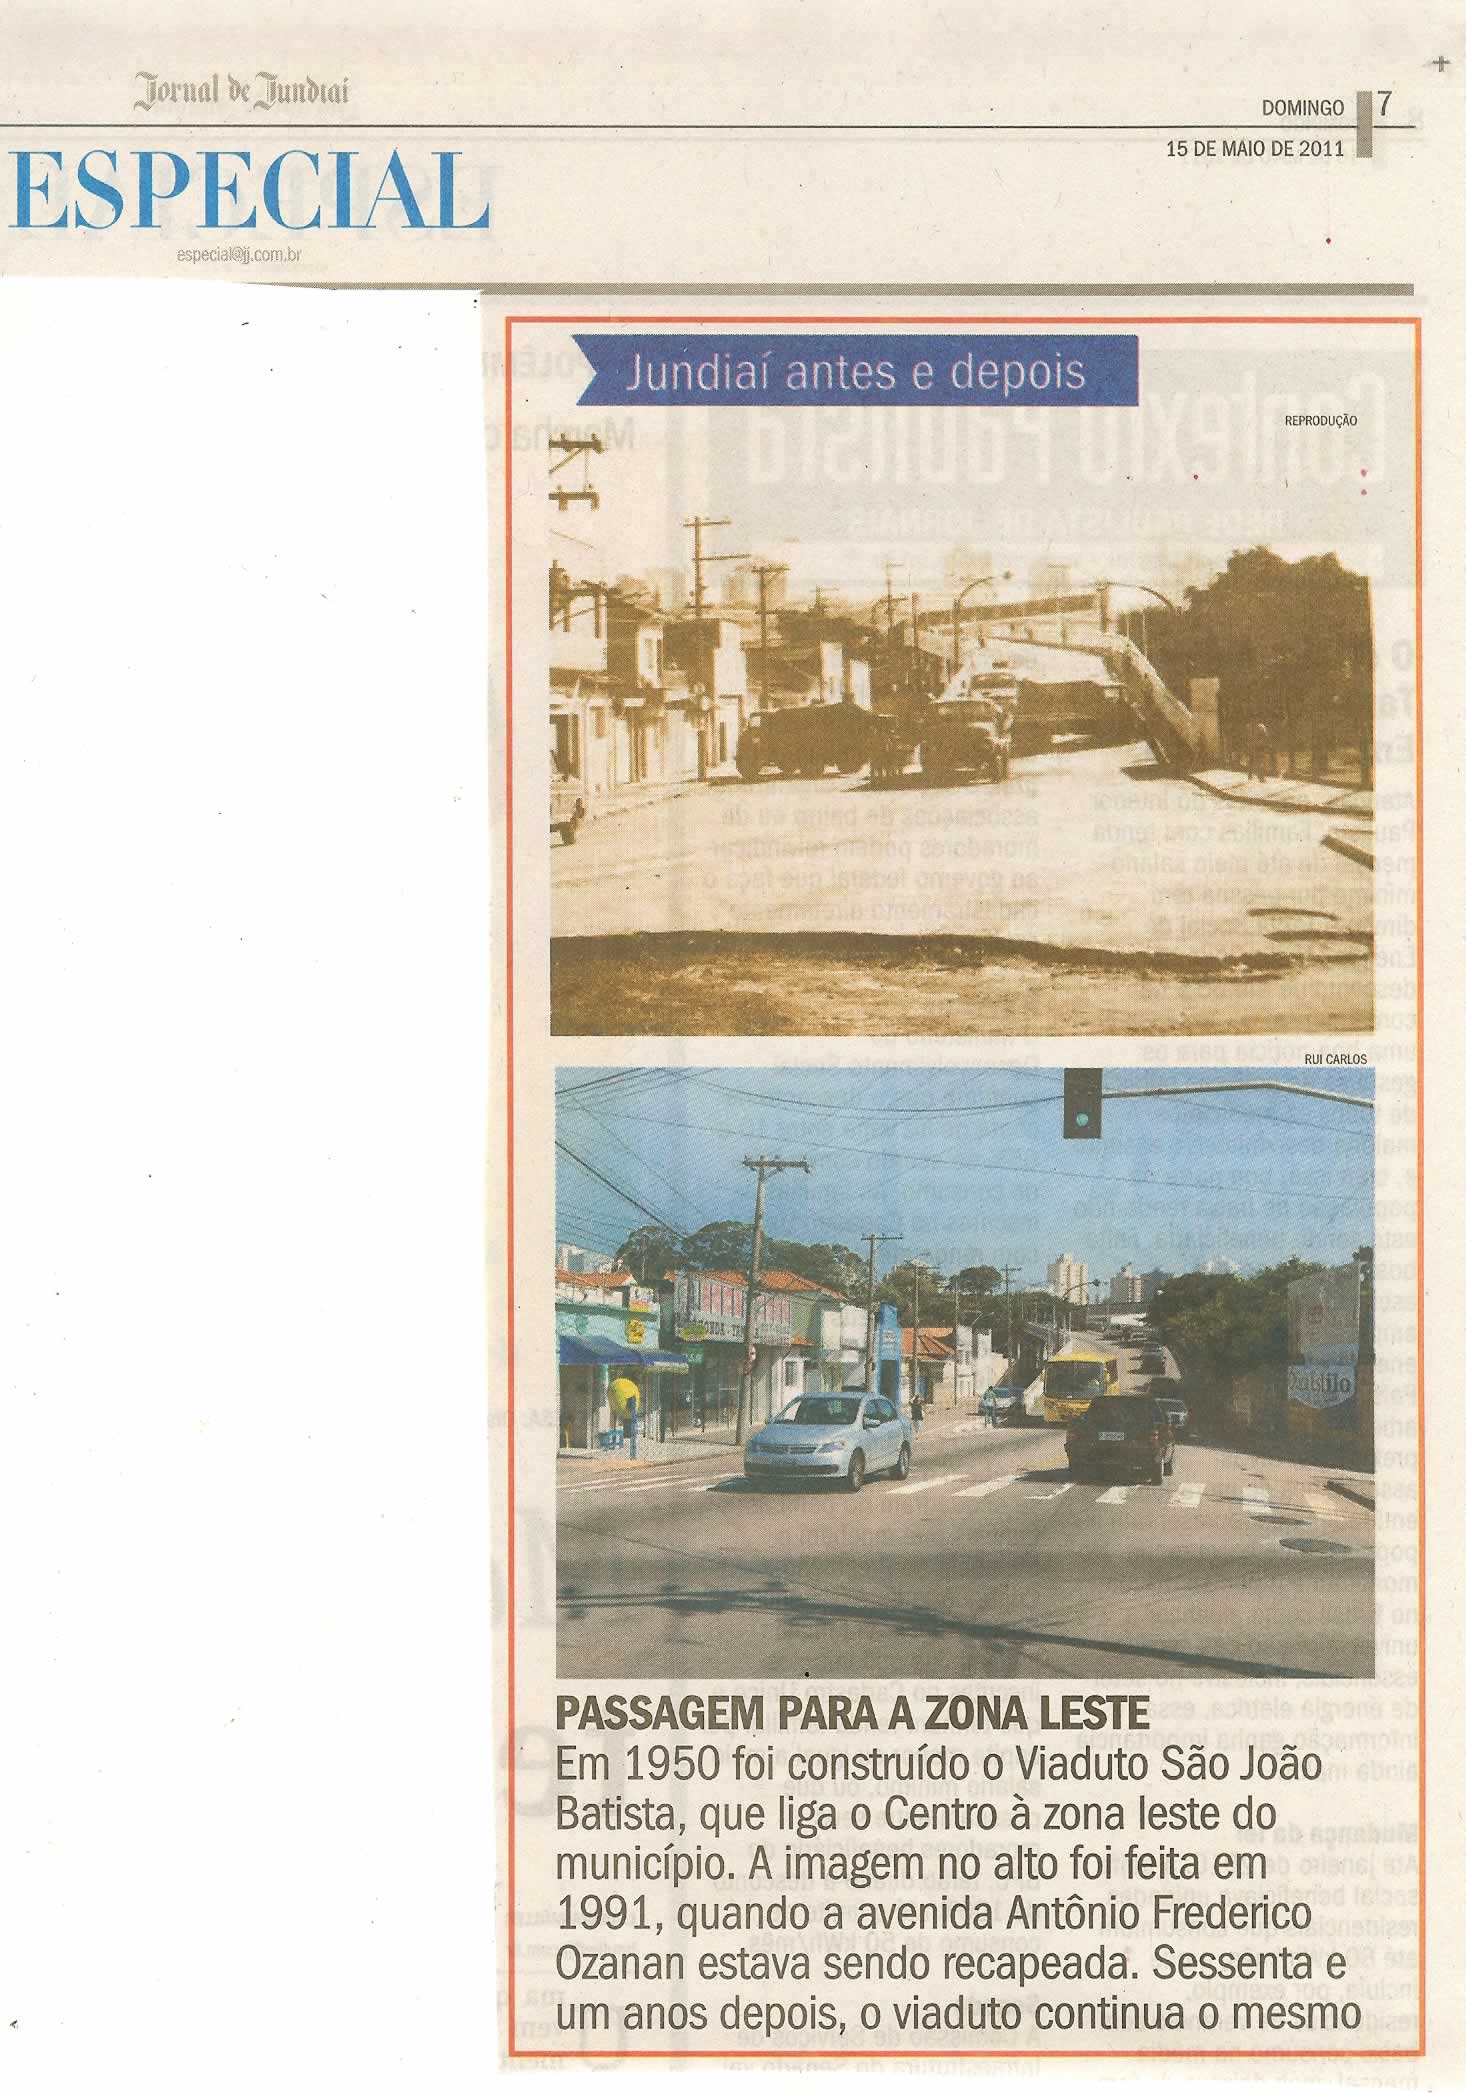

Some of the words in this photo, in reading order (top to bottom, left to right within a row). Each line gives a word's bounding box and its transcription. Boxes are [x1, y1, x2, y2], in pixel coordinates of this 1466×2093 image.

[134, 71, 219, 111] Jornal
[227, 72, 250, 103] de
[1263, 99, 1345, 116] DOMINGO
[1377, 90, 1393, 116] 7
[1167, 140, 1188, 157] 15
[1194, 140, 1217, 157] DE
[1222, 140, 1266, 157] MAIO
[1271, 140, 1294, 157] DE
[1299, 140, 1344, 157] 2011
[8, 147, 490, 230] ESPECIAL
[176, 246, 303, 265] especial@jj.com.br
[626, 350, 771, 391] Jundiaí
[785, 356, 896, 391] antes
[912, 361, 934, 391] e
[950, 351, 1086, 398] depois
[1285, 412, 1358, 430] REPRODUÇÃO
[1304, 1053, 1323, 1065] RUI
[1325, 1053, 1368, 1065] CARLOS
[556, 1694, 764, 1731] PASSAGEM
[779, 1695, 879, 1730] PARA
[887, 1695, 916, 1730] A
[924, 1694, 1029, 1730] ZONA
[1040, 1694, 1150, 1730] LESTE
[557, 1745, 609, 1780] Em
[627, 1744, 720, 1781] 1950
[732, 1744, 774, 1781] foi
[788, 1743, 970, 1781] construído
[983, 1753, 1004, 1781] o
[1015, 1744, 1149, 1781] Viaduto
[1161, 1744, 1230, 1781] São
[1239, 1744, 1322, 1781] João
[557, 1795, 686, 1836] Batista,
[700, 1803, 765, 1838] que
[779, 1795, 837, 1839] liga
[851, 1803, 871, 1831] o
[885, 1794, 998, 1831] Centro
[1010, 1793, 1031, 1831] à
[1043, 1803, 1125, 1831] zona
[1139, 1795, 1220, 1831] leste
[1232, 1795, 1277, 1830] do
[557, 1842, 735, 1888] município.
[748, 1845, 773, 1880] A
[785, 1844, 924, 1889] imagem
[939, 1852, 981, 1880] no
[994, 1844, 1058, 1880] alto
[1069, 1844, 1112, 1880] foi
[1124, 1844, 1200, 1880] feita
[1213, 1852, 1267, 1880] em
[559, 1894, 663, 1937] 1991,
[677, 1894, 810, 1938] quando
[823, 1903, 843, 1930] a
[855, 1894, 993, 1930] avenida
[1006, 1893, 1140, 1930] Antônio
[1154, 1894, 1312, 1930] Frederico
[556, 1944, 684, 1980] Ozanan
[698, 1947, 810, 1980] estava
[823, 1944, 930, 1980] sendo
[944, 1944, 1138, 1988] recapeada.
[1152, 1943, 1312, 1980] Sessenta
[1326, 1952, 1347, 1980] e
[557, 2003, 609, 2030] um
[623, 2002, 708, 2030] anos
[720, 1994, 846, 2038] depois,
[860, 2003, 881, 2030] o
[893, 1994, 1022, 2030] viaduto
[1034, 1994, 1185, 2030] continua
[1198, 2002, 1219, 2030] o
[1233, 2002, 1362, 2030] mesmo
